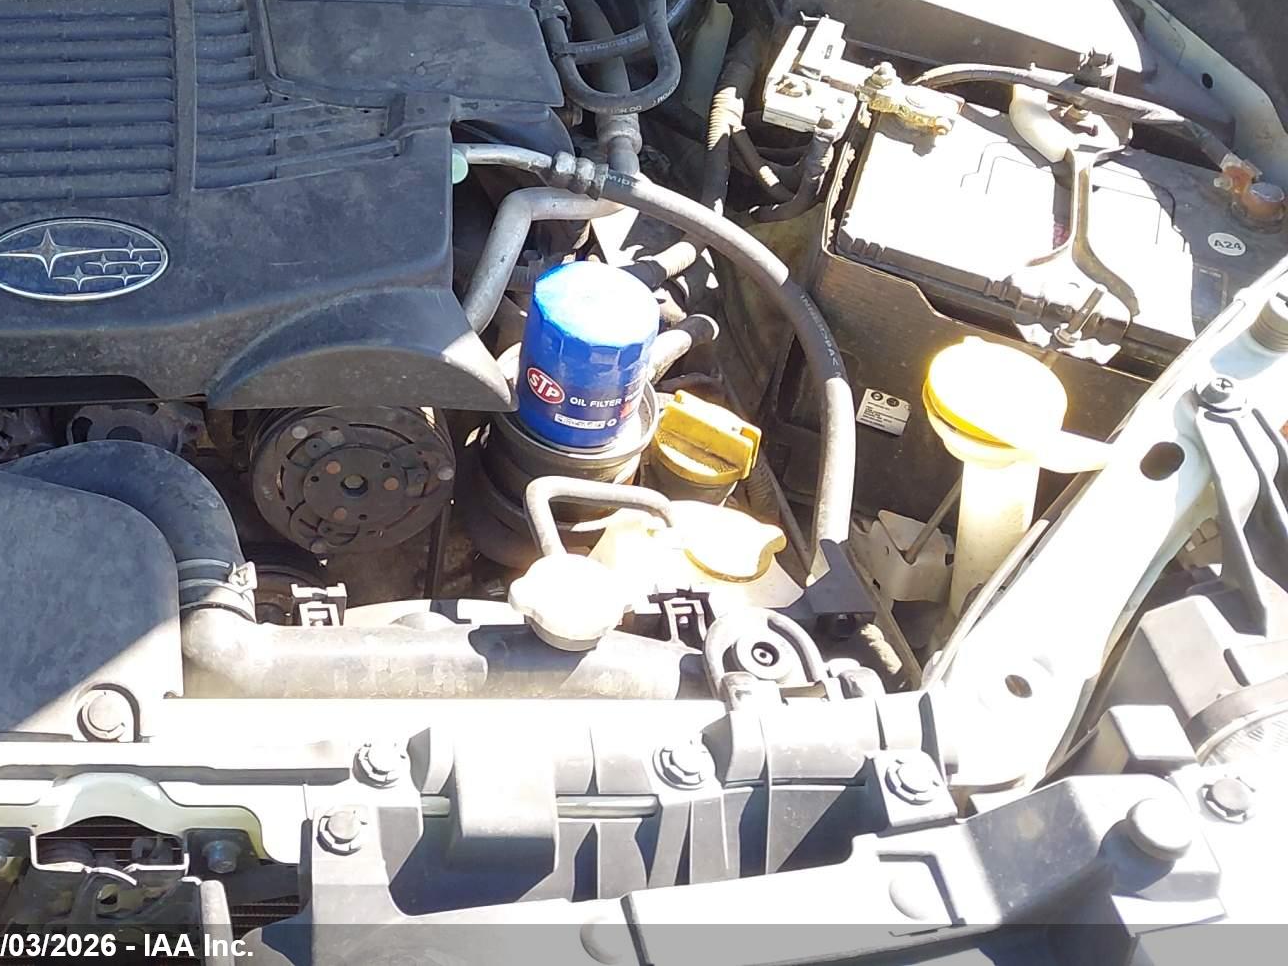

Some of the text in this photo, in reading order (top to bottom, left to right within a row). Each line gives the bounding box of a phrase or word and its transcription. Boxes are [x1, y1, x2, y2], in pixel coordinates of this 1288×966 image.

[529, 373, 561, 398] STP
[569, 396, 623, 408] OIL FILTER
